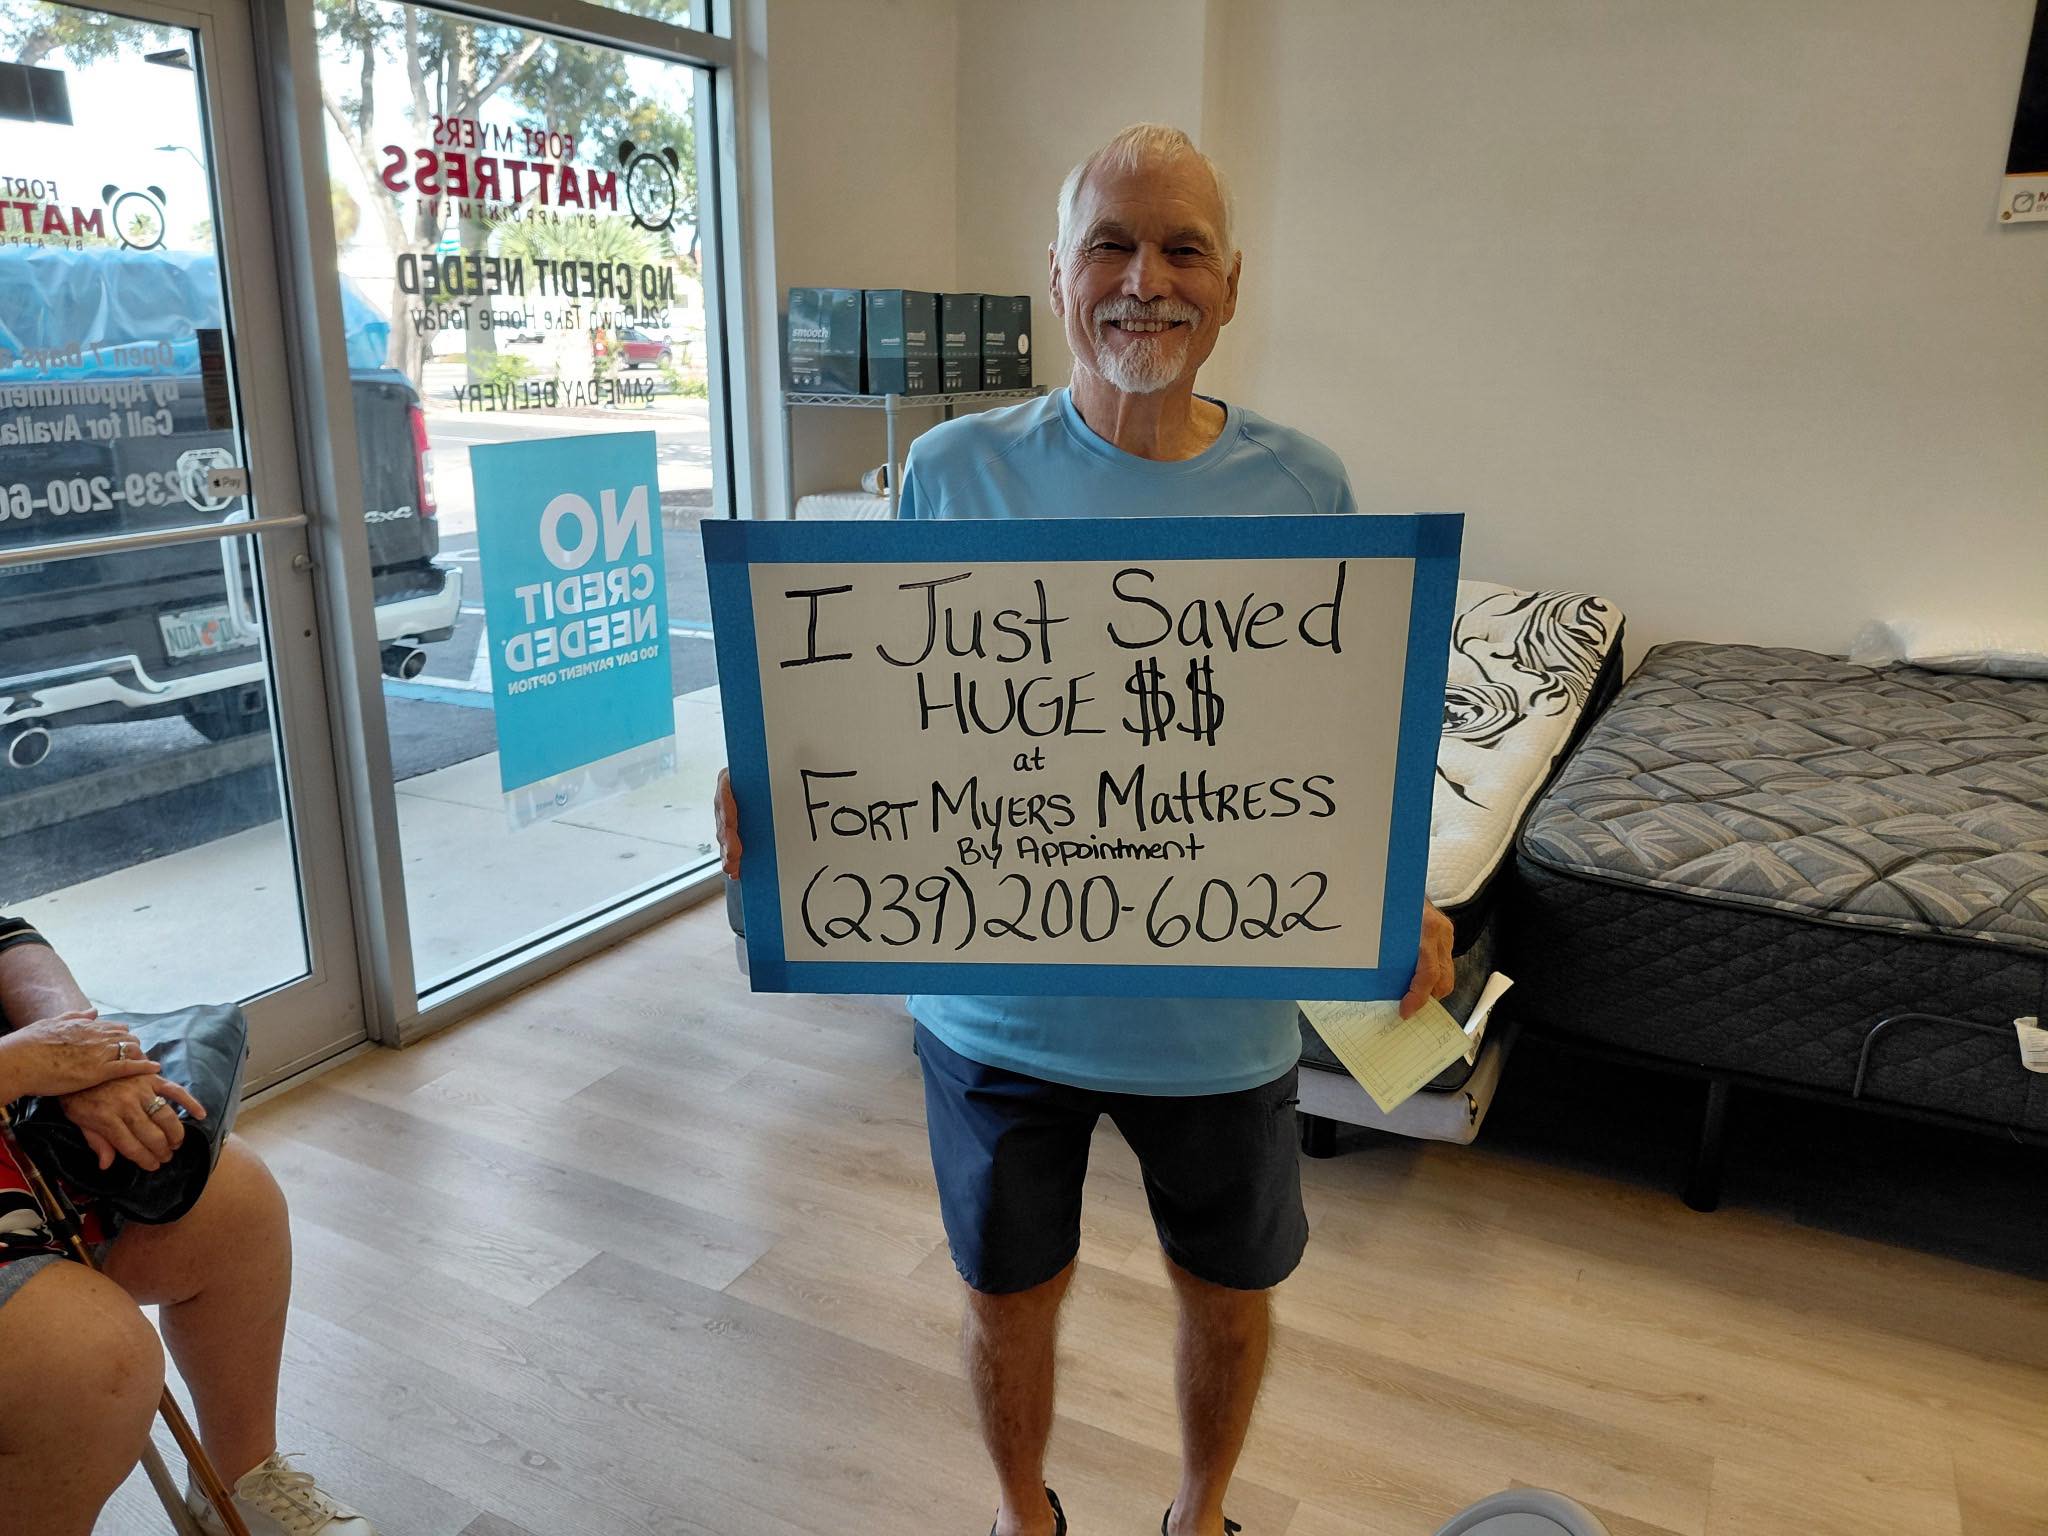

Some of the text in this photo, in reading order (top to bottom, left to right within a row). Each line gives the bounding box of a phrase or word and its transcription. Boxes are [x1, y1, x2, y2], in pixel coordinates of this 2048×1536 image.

[780, 561, 1347, 668] I Just Saved
[917, 656, 1225, 746] HUGE $$
[1013, 745, 1046, 772] at
[800, 769, 919, 842] FORT
[957, 832, 1205, 870] By Appointment
